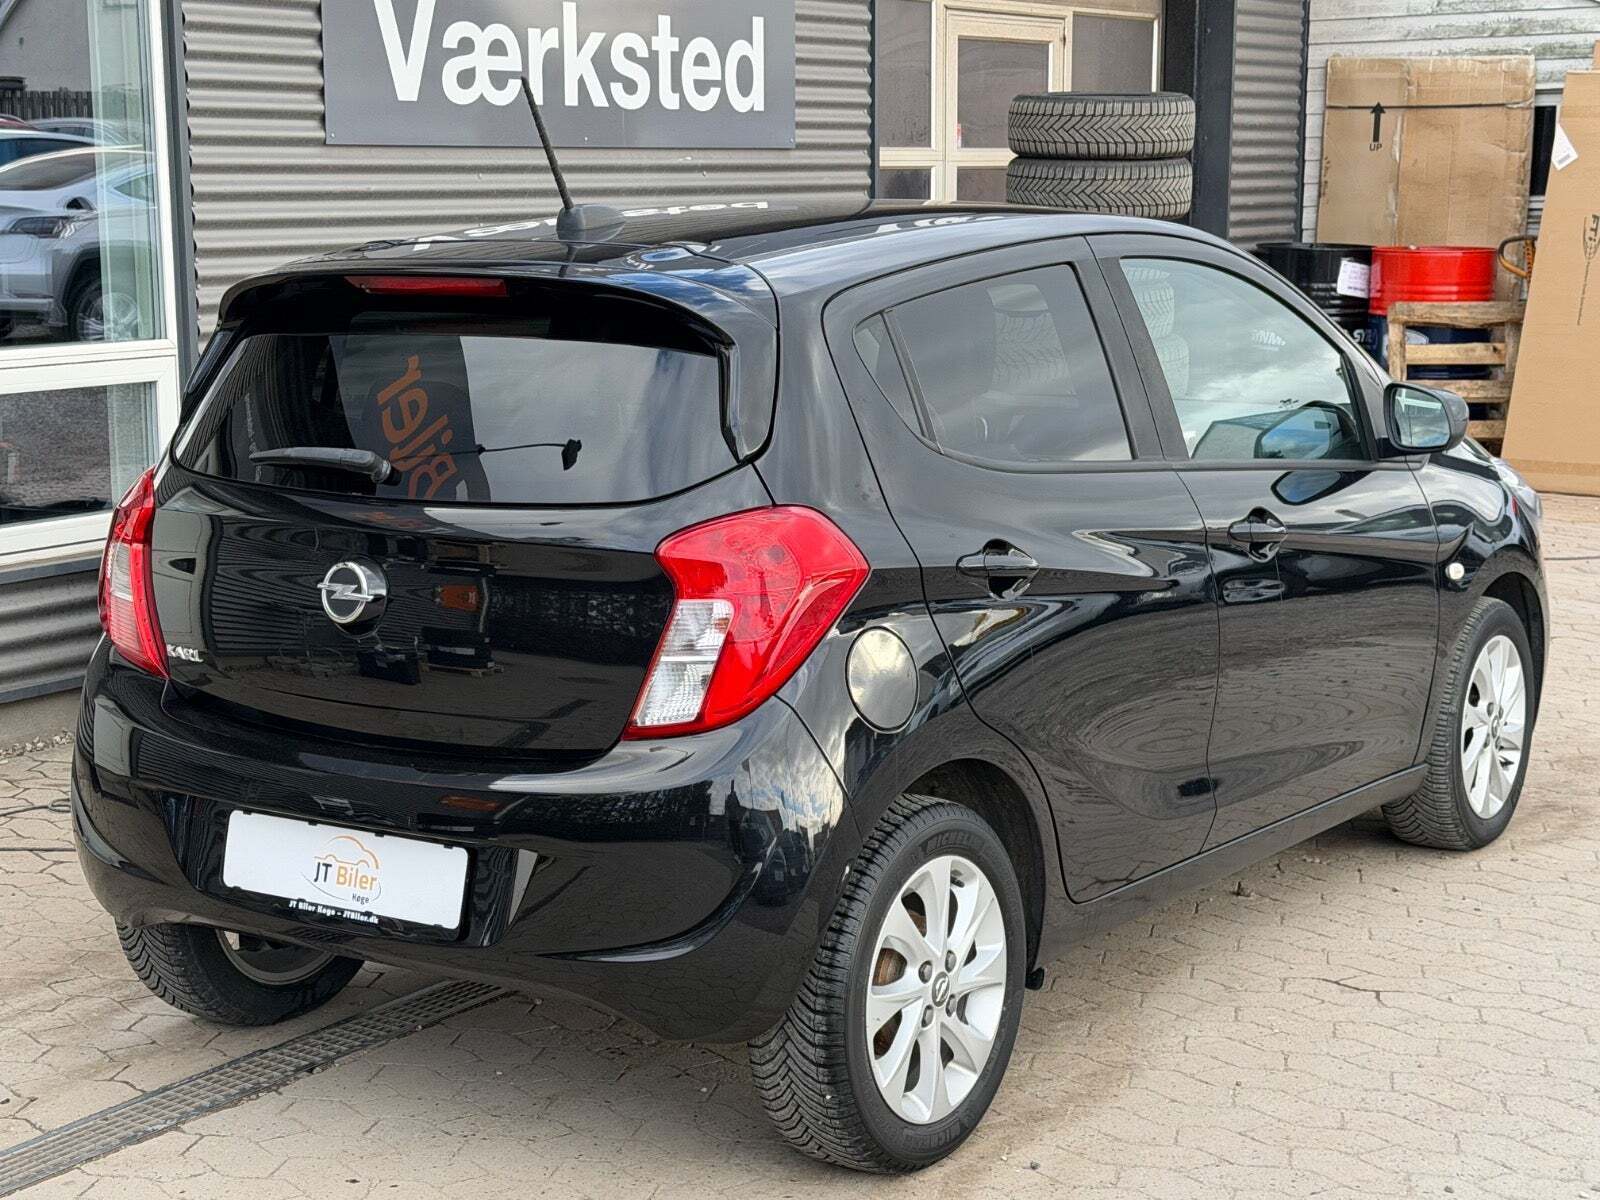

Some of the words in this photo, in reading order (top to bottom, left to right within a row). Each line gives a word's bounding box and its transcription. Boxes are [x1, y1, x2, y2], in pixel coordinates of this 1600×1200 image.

[374, 0, 766, 113] Værksted
[1369, 143, 1383, 152] UP
[313, 861, 333, 883] JT
[335, 865, 378, 892] Biler
[288, 900, 298, 908] JT
[298, 901, 316, 912] Biler
